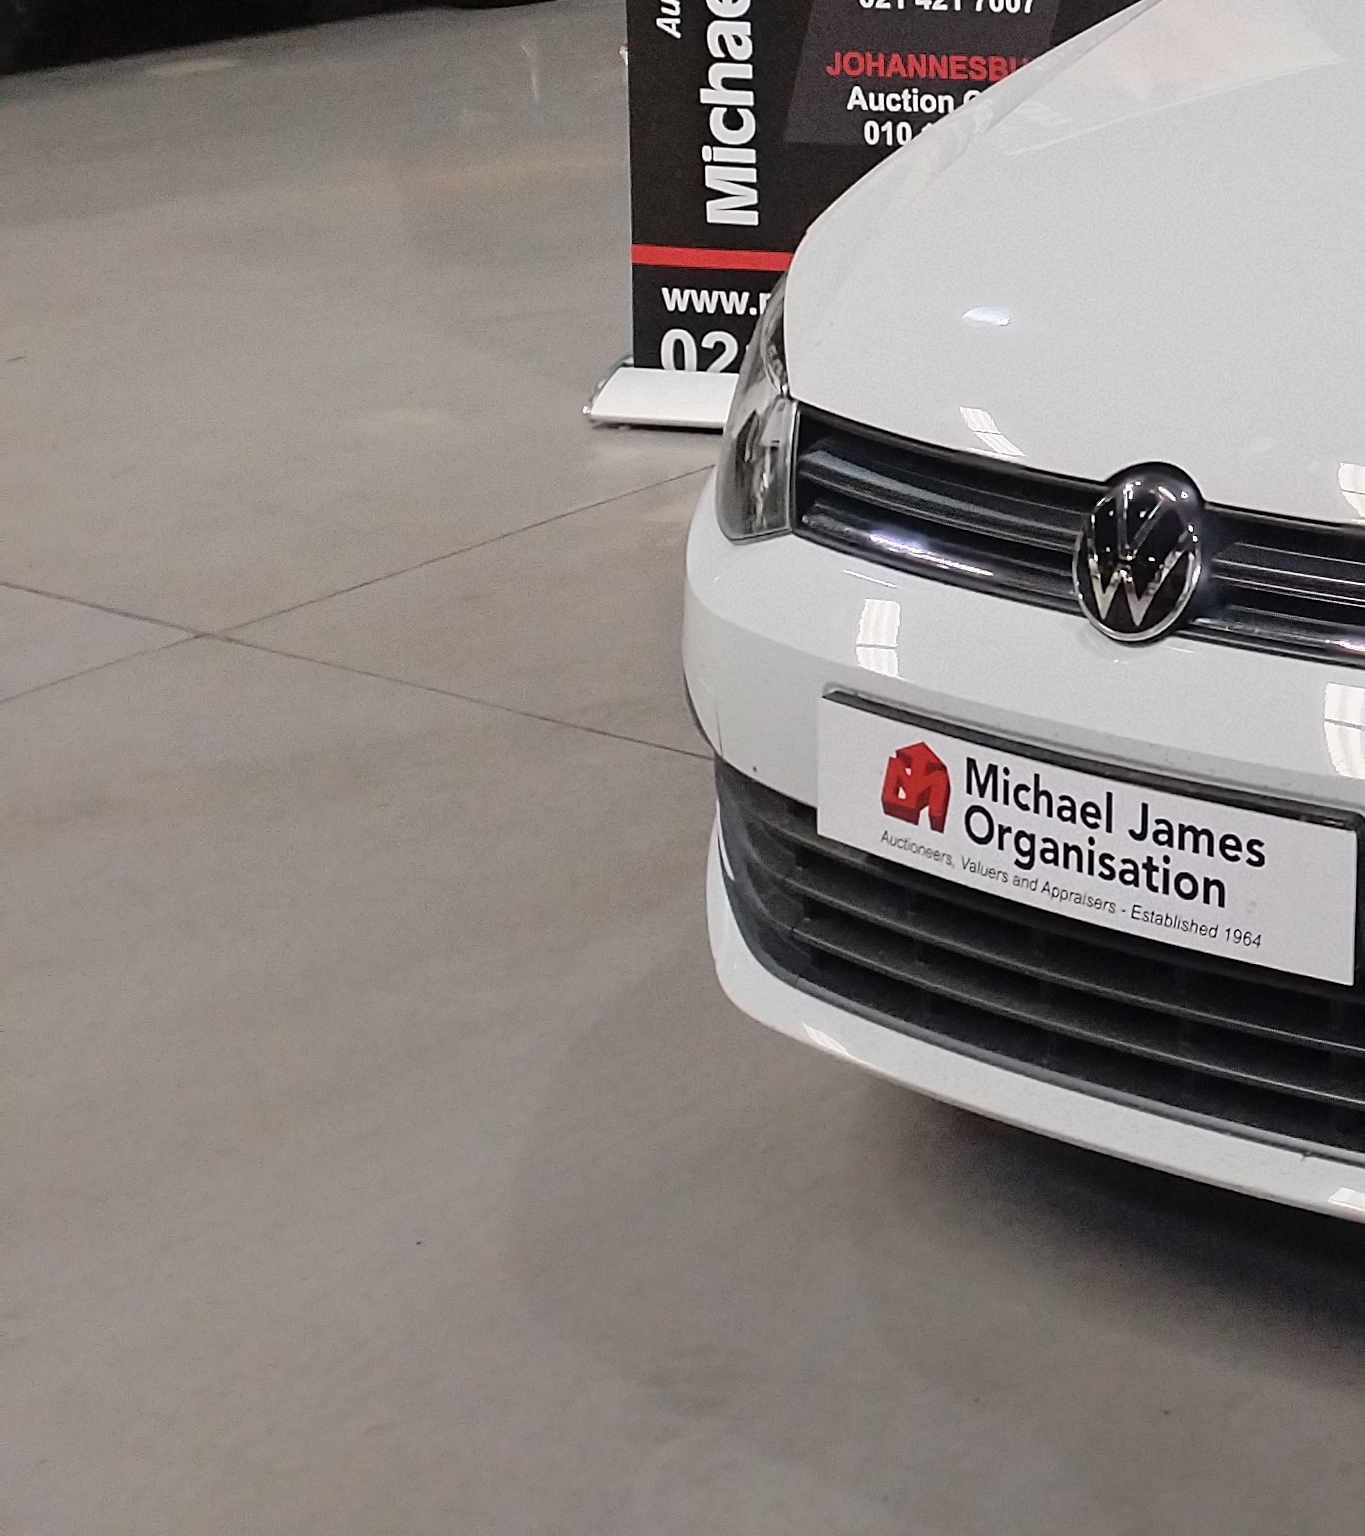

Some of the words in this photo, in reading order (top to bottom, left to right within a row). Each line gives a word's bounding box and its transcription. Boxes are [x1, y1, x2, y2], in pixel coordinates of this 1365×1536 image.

[846, 85, 955, 114] Auction
[863, 120, 912, 147] 010
[660, 328, 750, 374] 02
[965, 756, 1114, 834] Michael
[1127, 802, 1267, 868] James
[880, 830, 956, 869] Auctioneers,
[960, 856, 1009, 884] Valuers
[1012, 873, 1039, 893] and
[1040, 881, 1117, 915] Appraisers
[1130, 904, 1219, 940] Established
[1224, 927, 1263, 949] 1964
[963, 804, 1227, 909] Organisation
